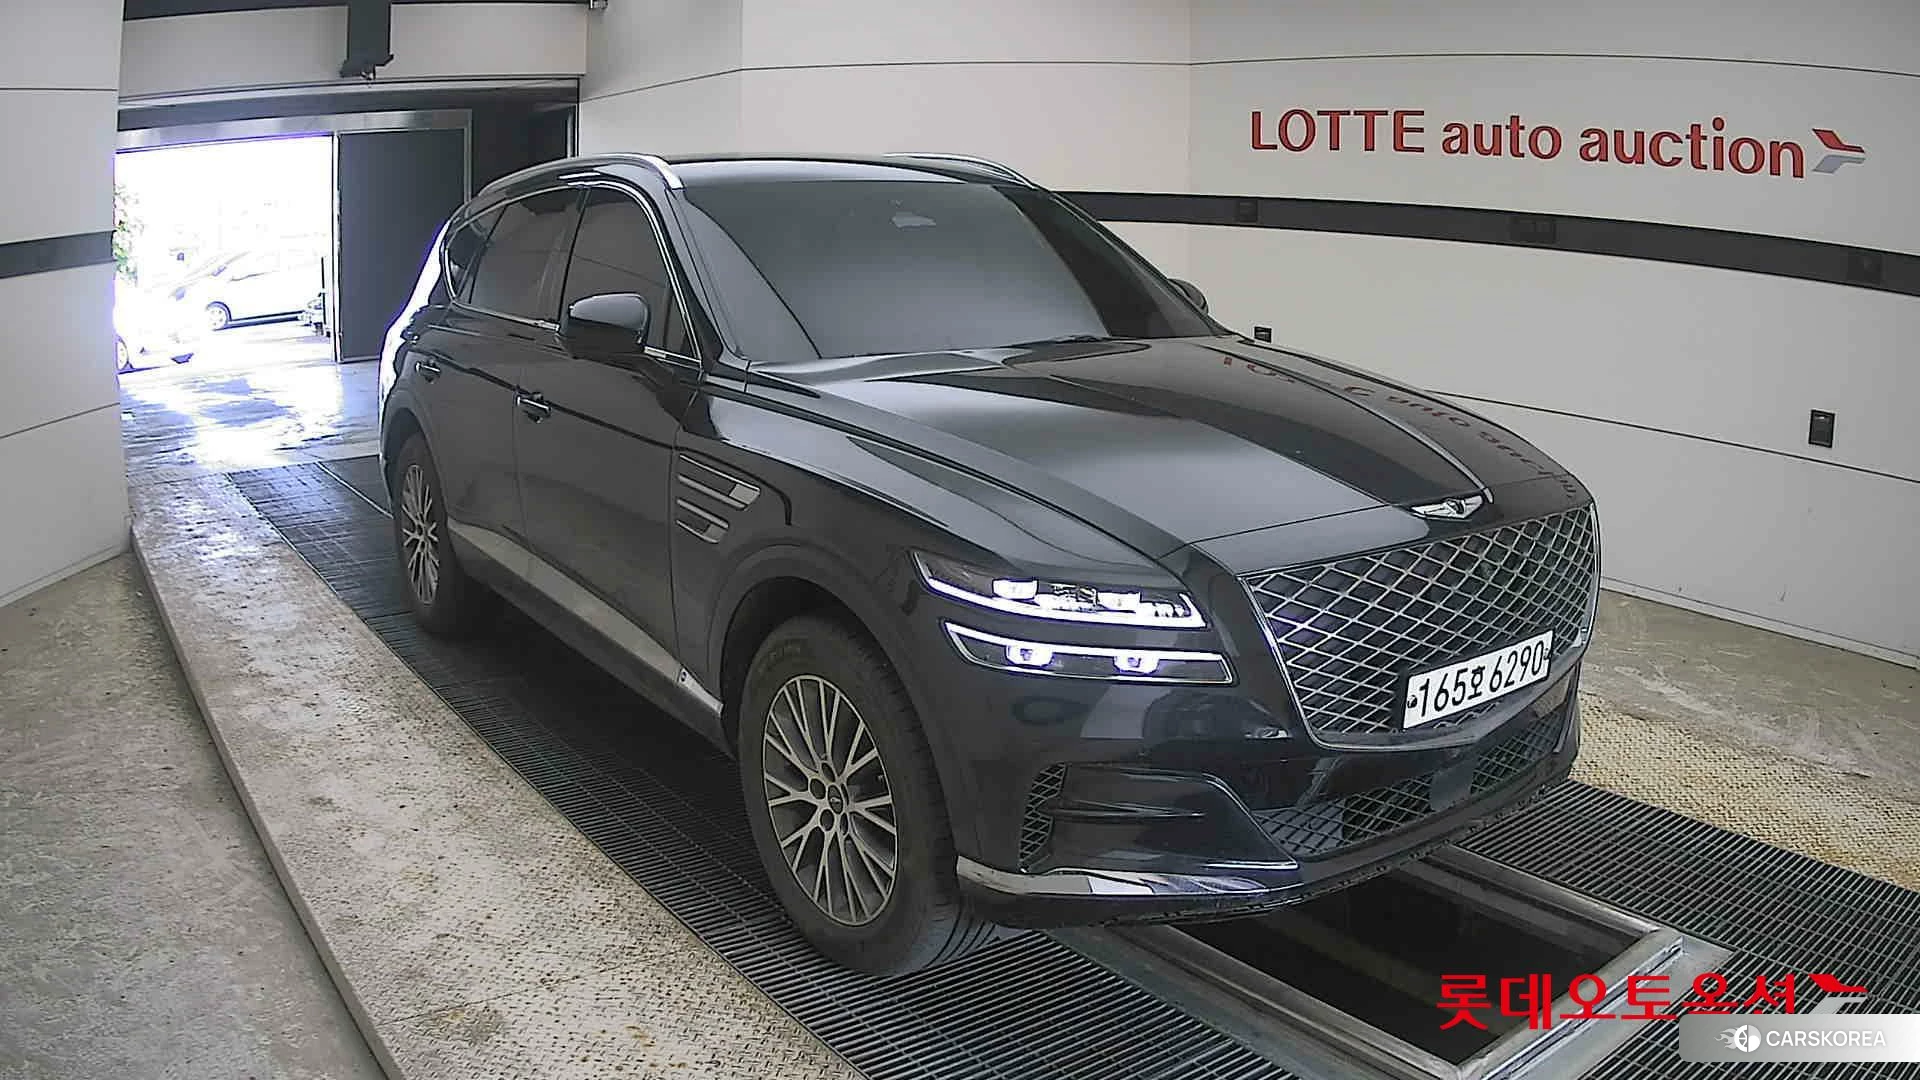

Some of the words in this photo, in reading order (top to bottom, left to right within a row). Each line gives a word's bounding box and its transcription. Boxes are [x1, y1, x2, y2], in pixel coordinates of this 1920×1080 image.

[1251, 109, 1425, 152] LOTTE
[1441, 115, 1562, 159] auto
[1579, 117, 1805, 178] auction
